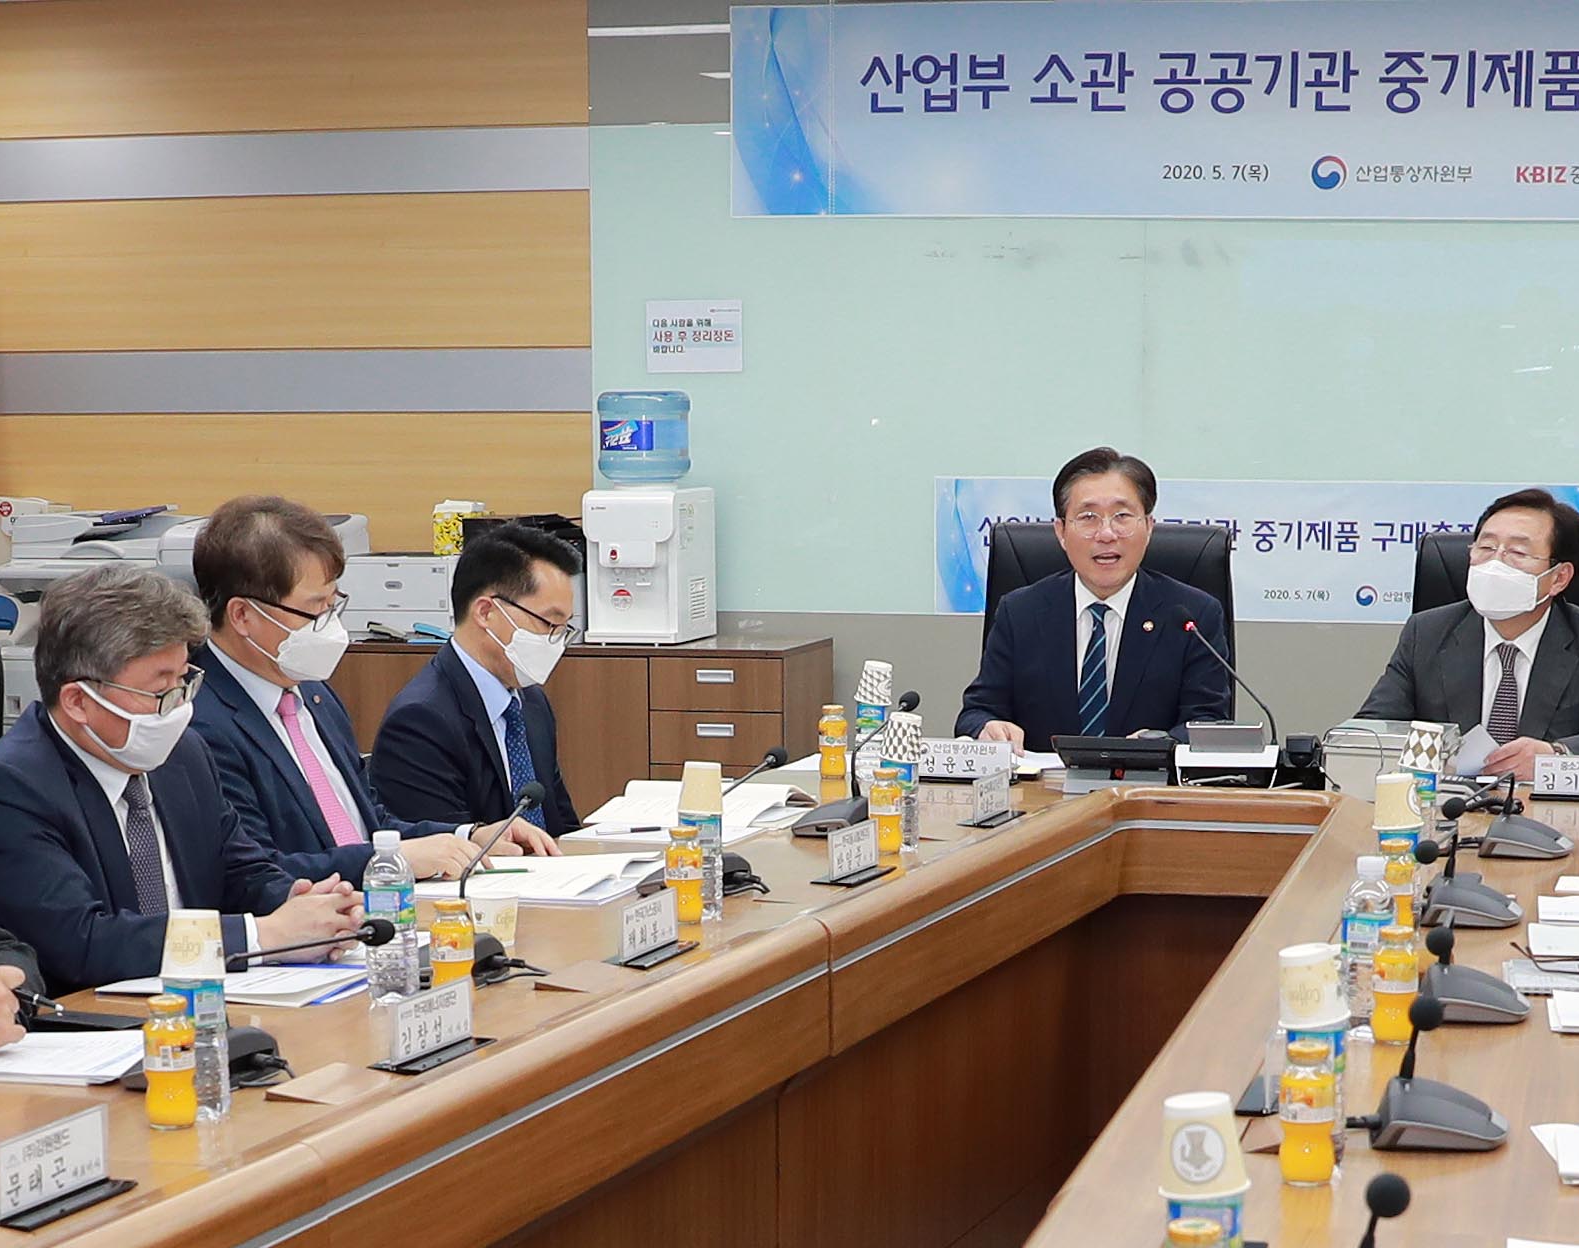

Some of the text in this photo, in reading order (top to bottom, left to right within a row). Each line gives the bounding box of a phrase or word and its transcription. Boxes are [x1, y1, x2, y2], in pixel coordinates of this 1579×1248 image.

[860, 52, 1010, 113] 산업부
[1029, 51, 1134, 113] 소관
[1153, 50, 1360, 115] 공공기관
[1162, 163, 1270, 184] 2020. 5. 7(목)
[1356, 165, 1473, 184] 산업통상자원부
[653, 330, 673, 343] 사용
[692, 329, 734, 343] 정리정돈
[1251, 519, 1361, 553] 중기제품
[1371, 520, 1474, 552] 구매
[1263, 588, 1292, 601] 2020.
